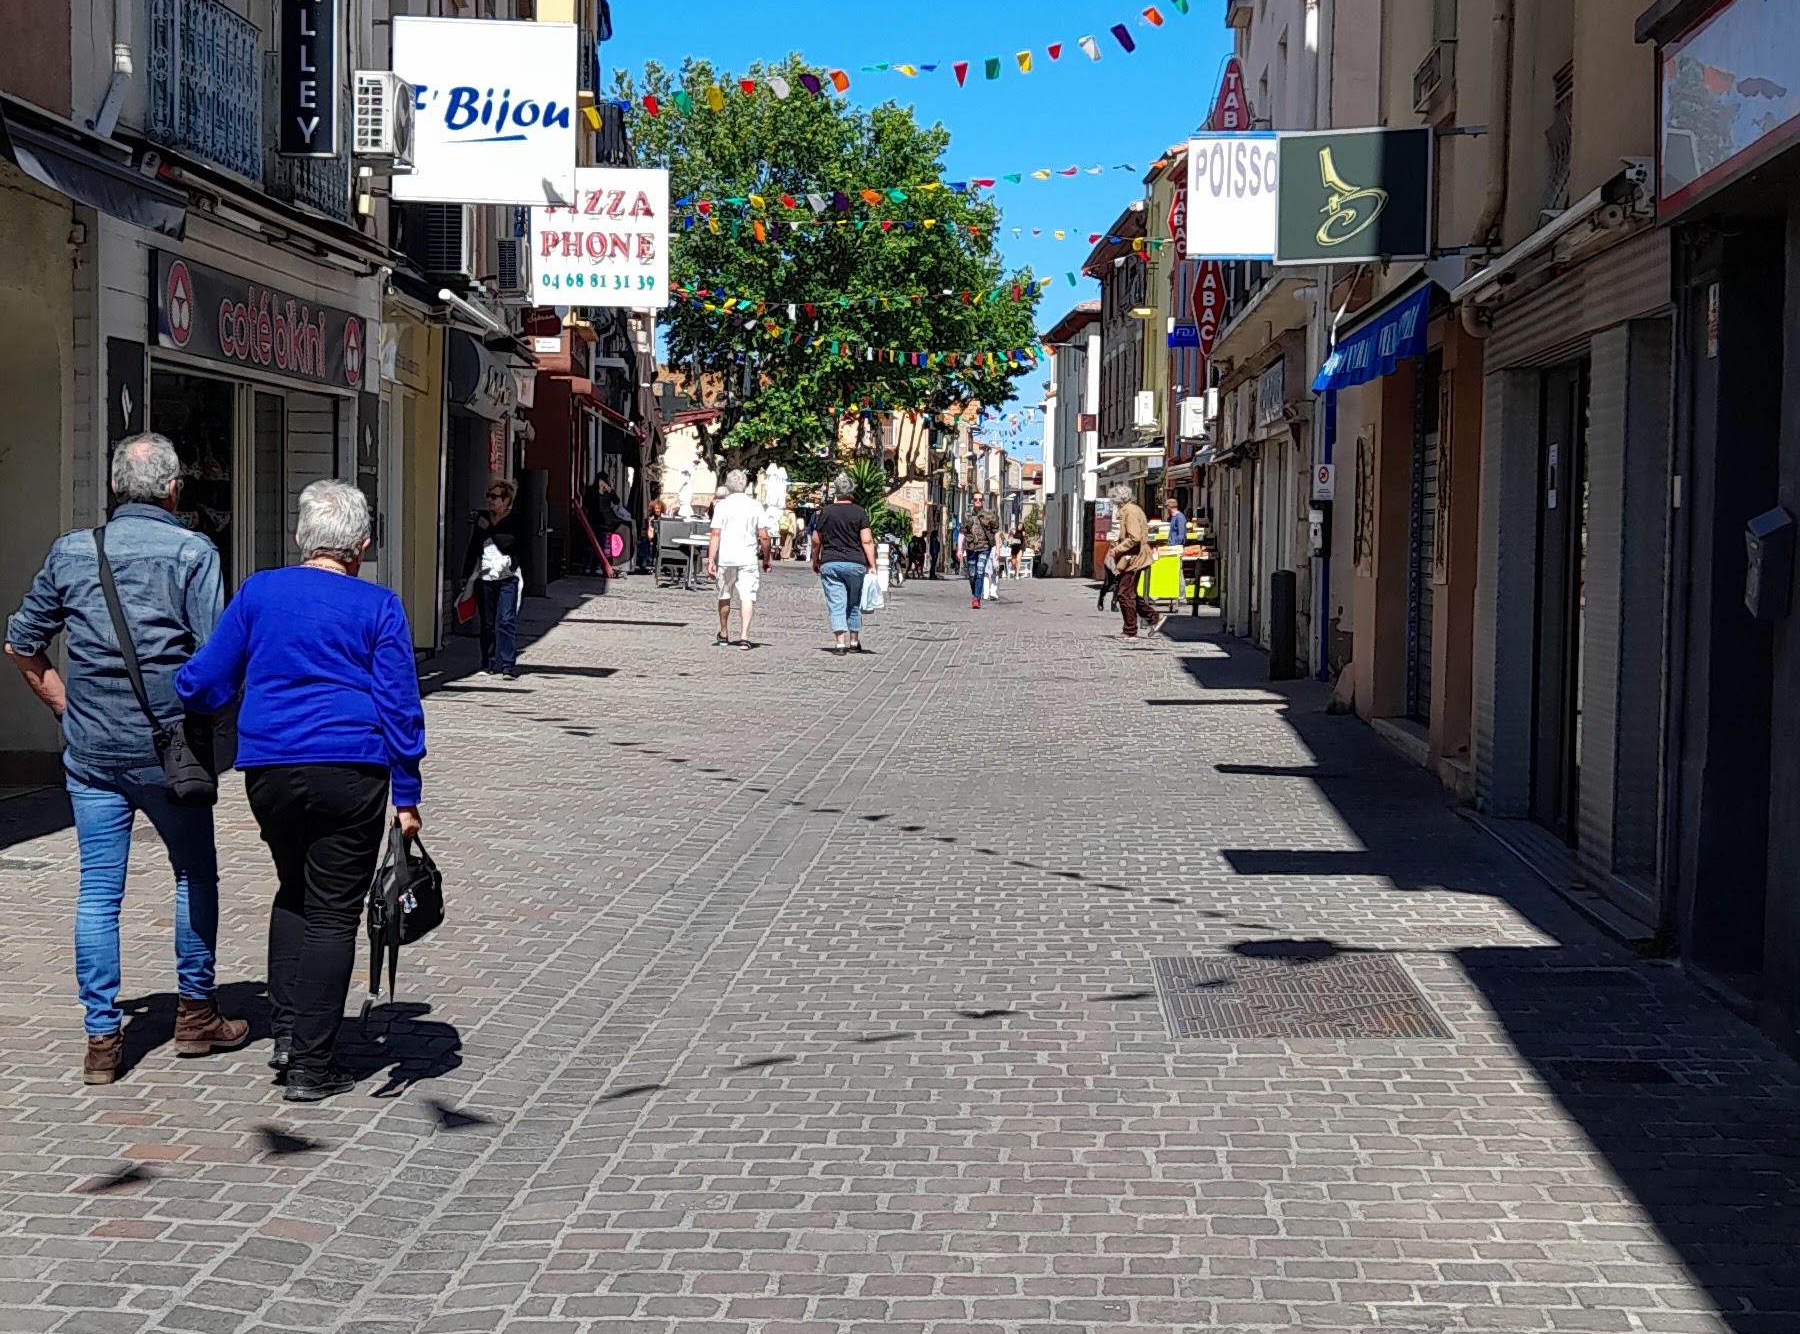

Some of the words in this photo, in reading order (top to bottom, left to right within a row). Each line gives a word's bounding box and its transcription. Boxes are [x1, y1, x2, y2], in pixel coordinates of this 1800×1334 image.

[1195, 142, 1276, 198] POISSO
[544, 188, 655, 217] IZZA
[1173, 189, 1187, 254] TABAC
[540, 230, 656, 261] PHONE
[542, 273, 560, 290] 04
[566, 273, 584, 288] 68
[590, 273, 607, 288] 81
[614, 275, 630, 290] 31
[637, 275, 655, 291] 39
[1176, 328, 1196, 337] FDJ
